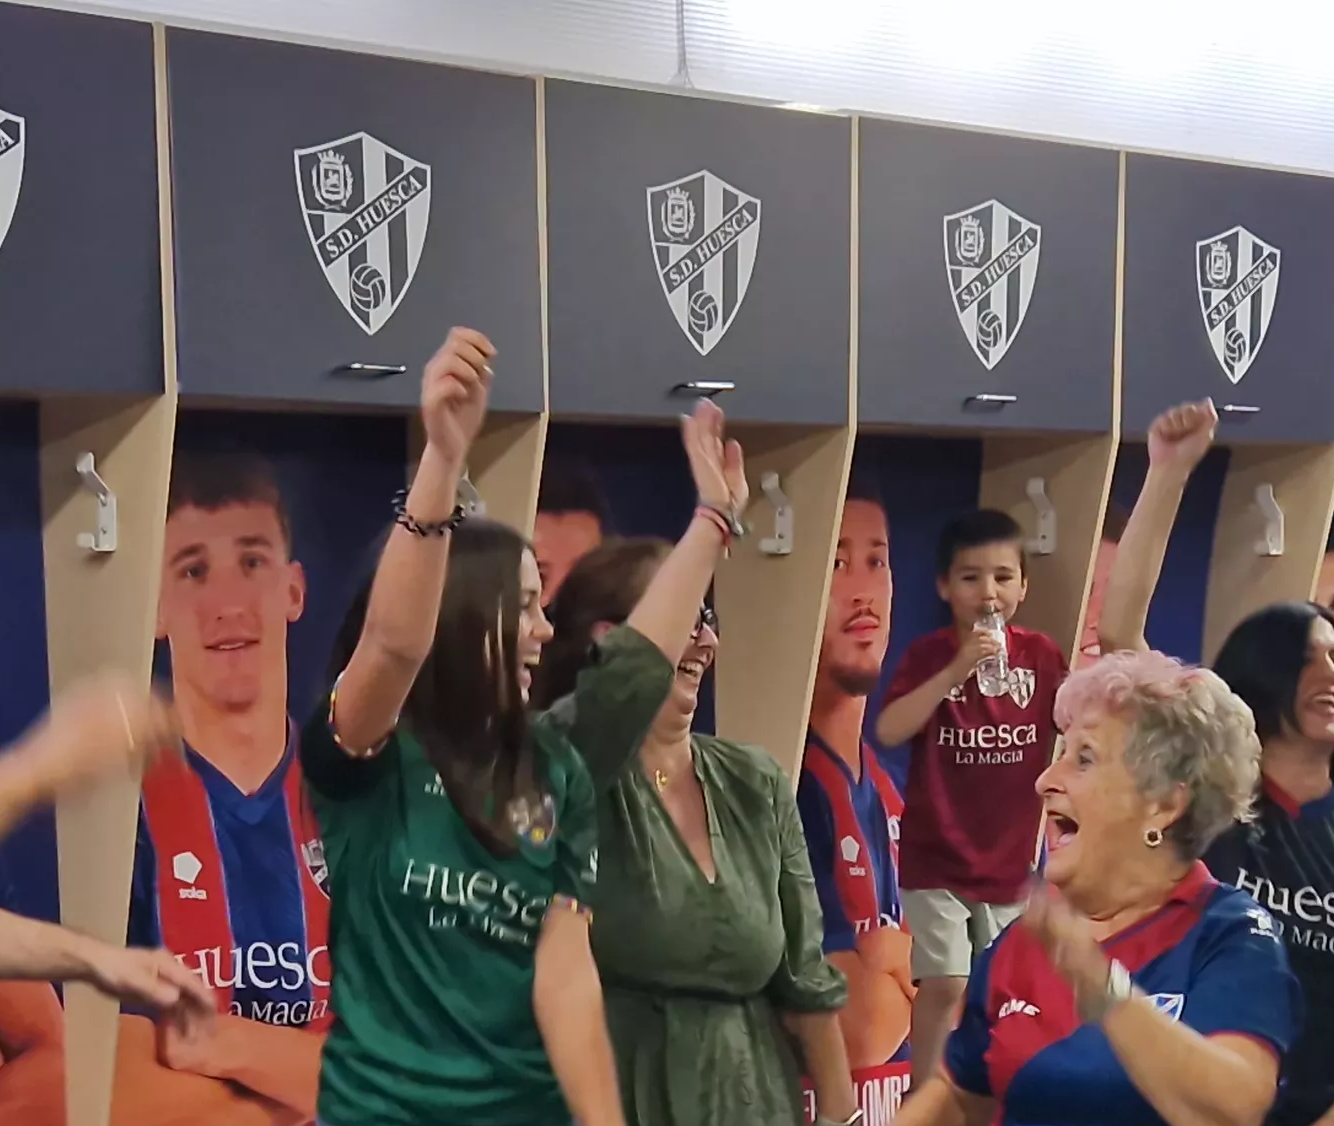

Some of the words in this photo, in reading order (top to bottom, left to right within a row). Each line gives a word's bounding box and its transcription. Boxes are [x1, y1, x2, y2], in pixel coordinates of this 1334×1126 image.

[325, 228, 359, 258] S.D.
[355, 174, 422, 233] HUESCA
[695, 208, 753, 263] HUESCA
